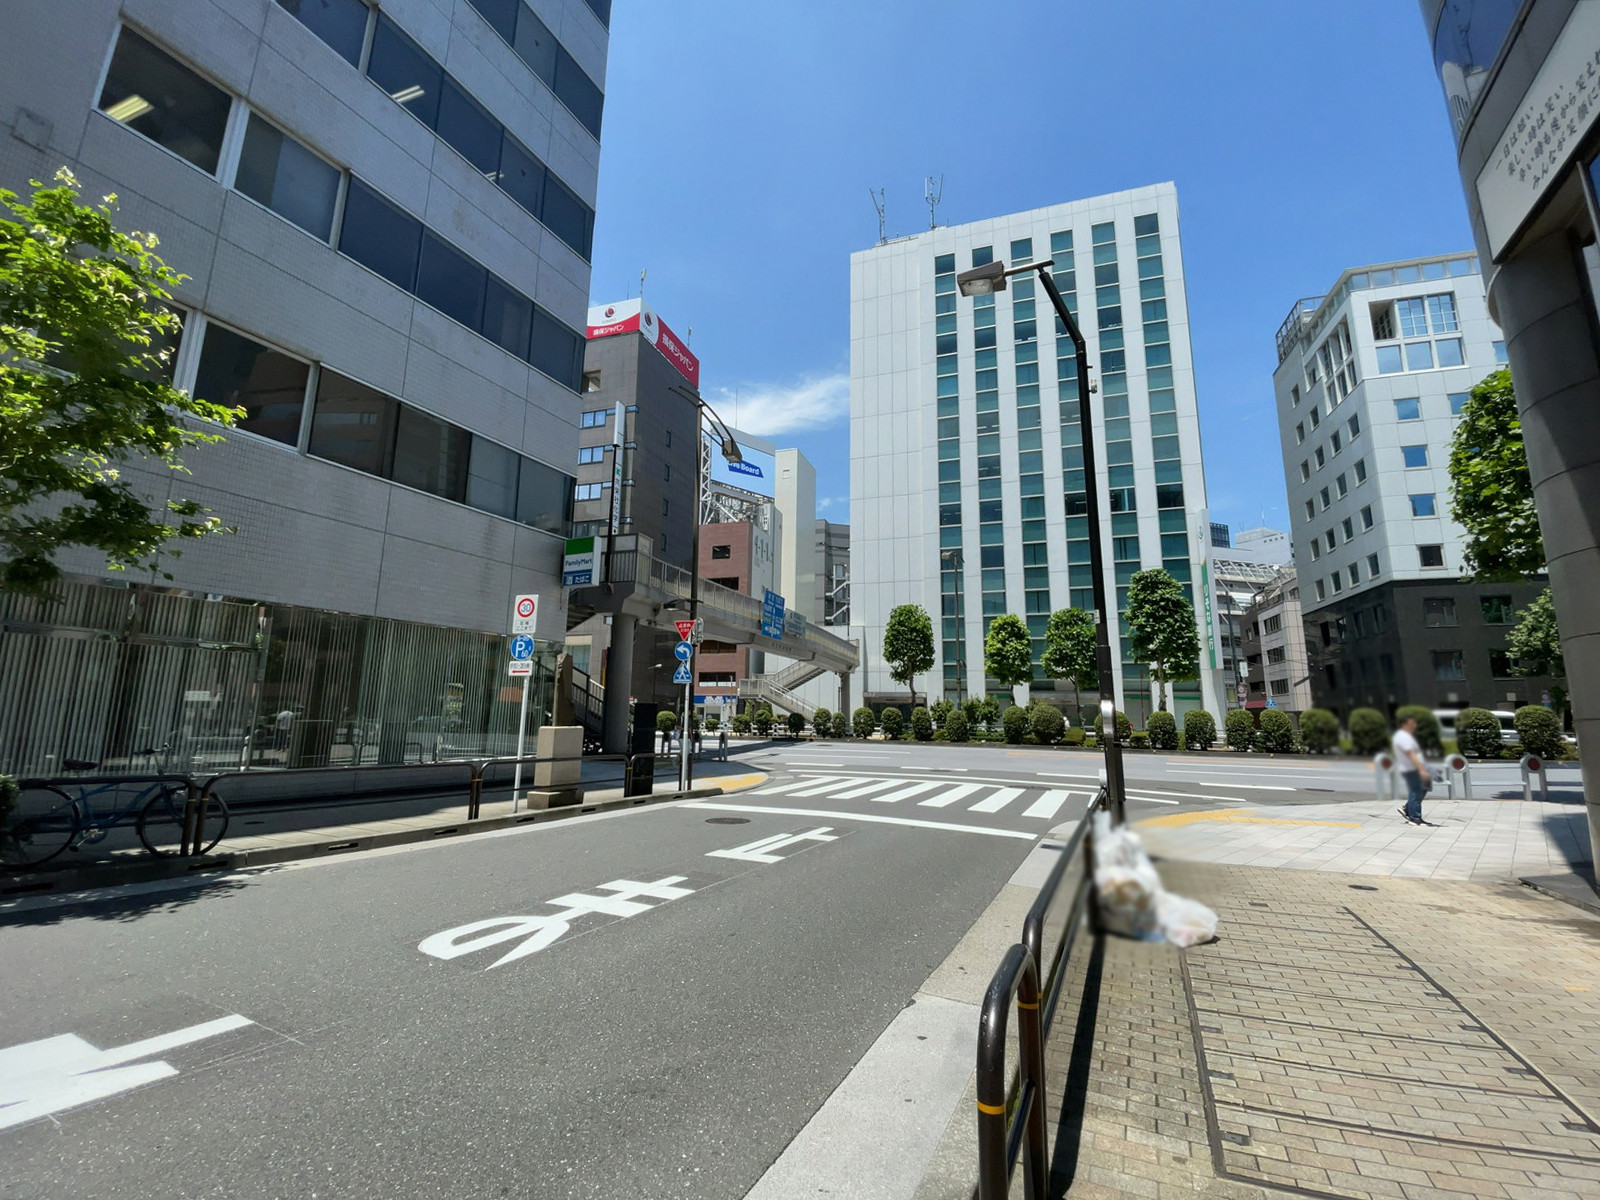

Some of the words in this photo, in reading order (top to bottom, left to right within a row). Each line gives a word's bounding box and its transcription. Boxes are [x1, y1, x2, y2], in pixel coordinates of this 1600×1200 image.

[565, 558, 592, 567] FamilyMart
[520, 603, 532, 613] 30
[515, 641, 526, 658] P
